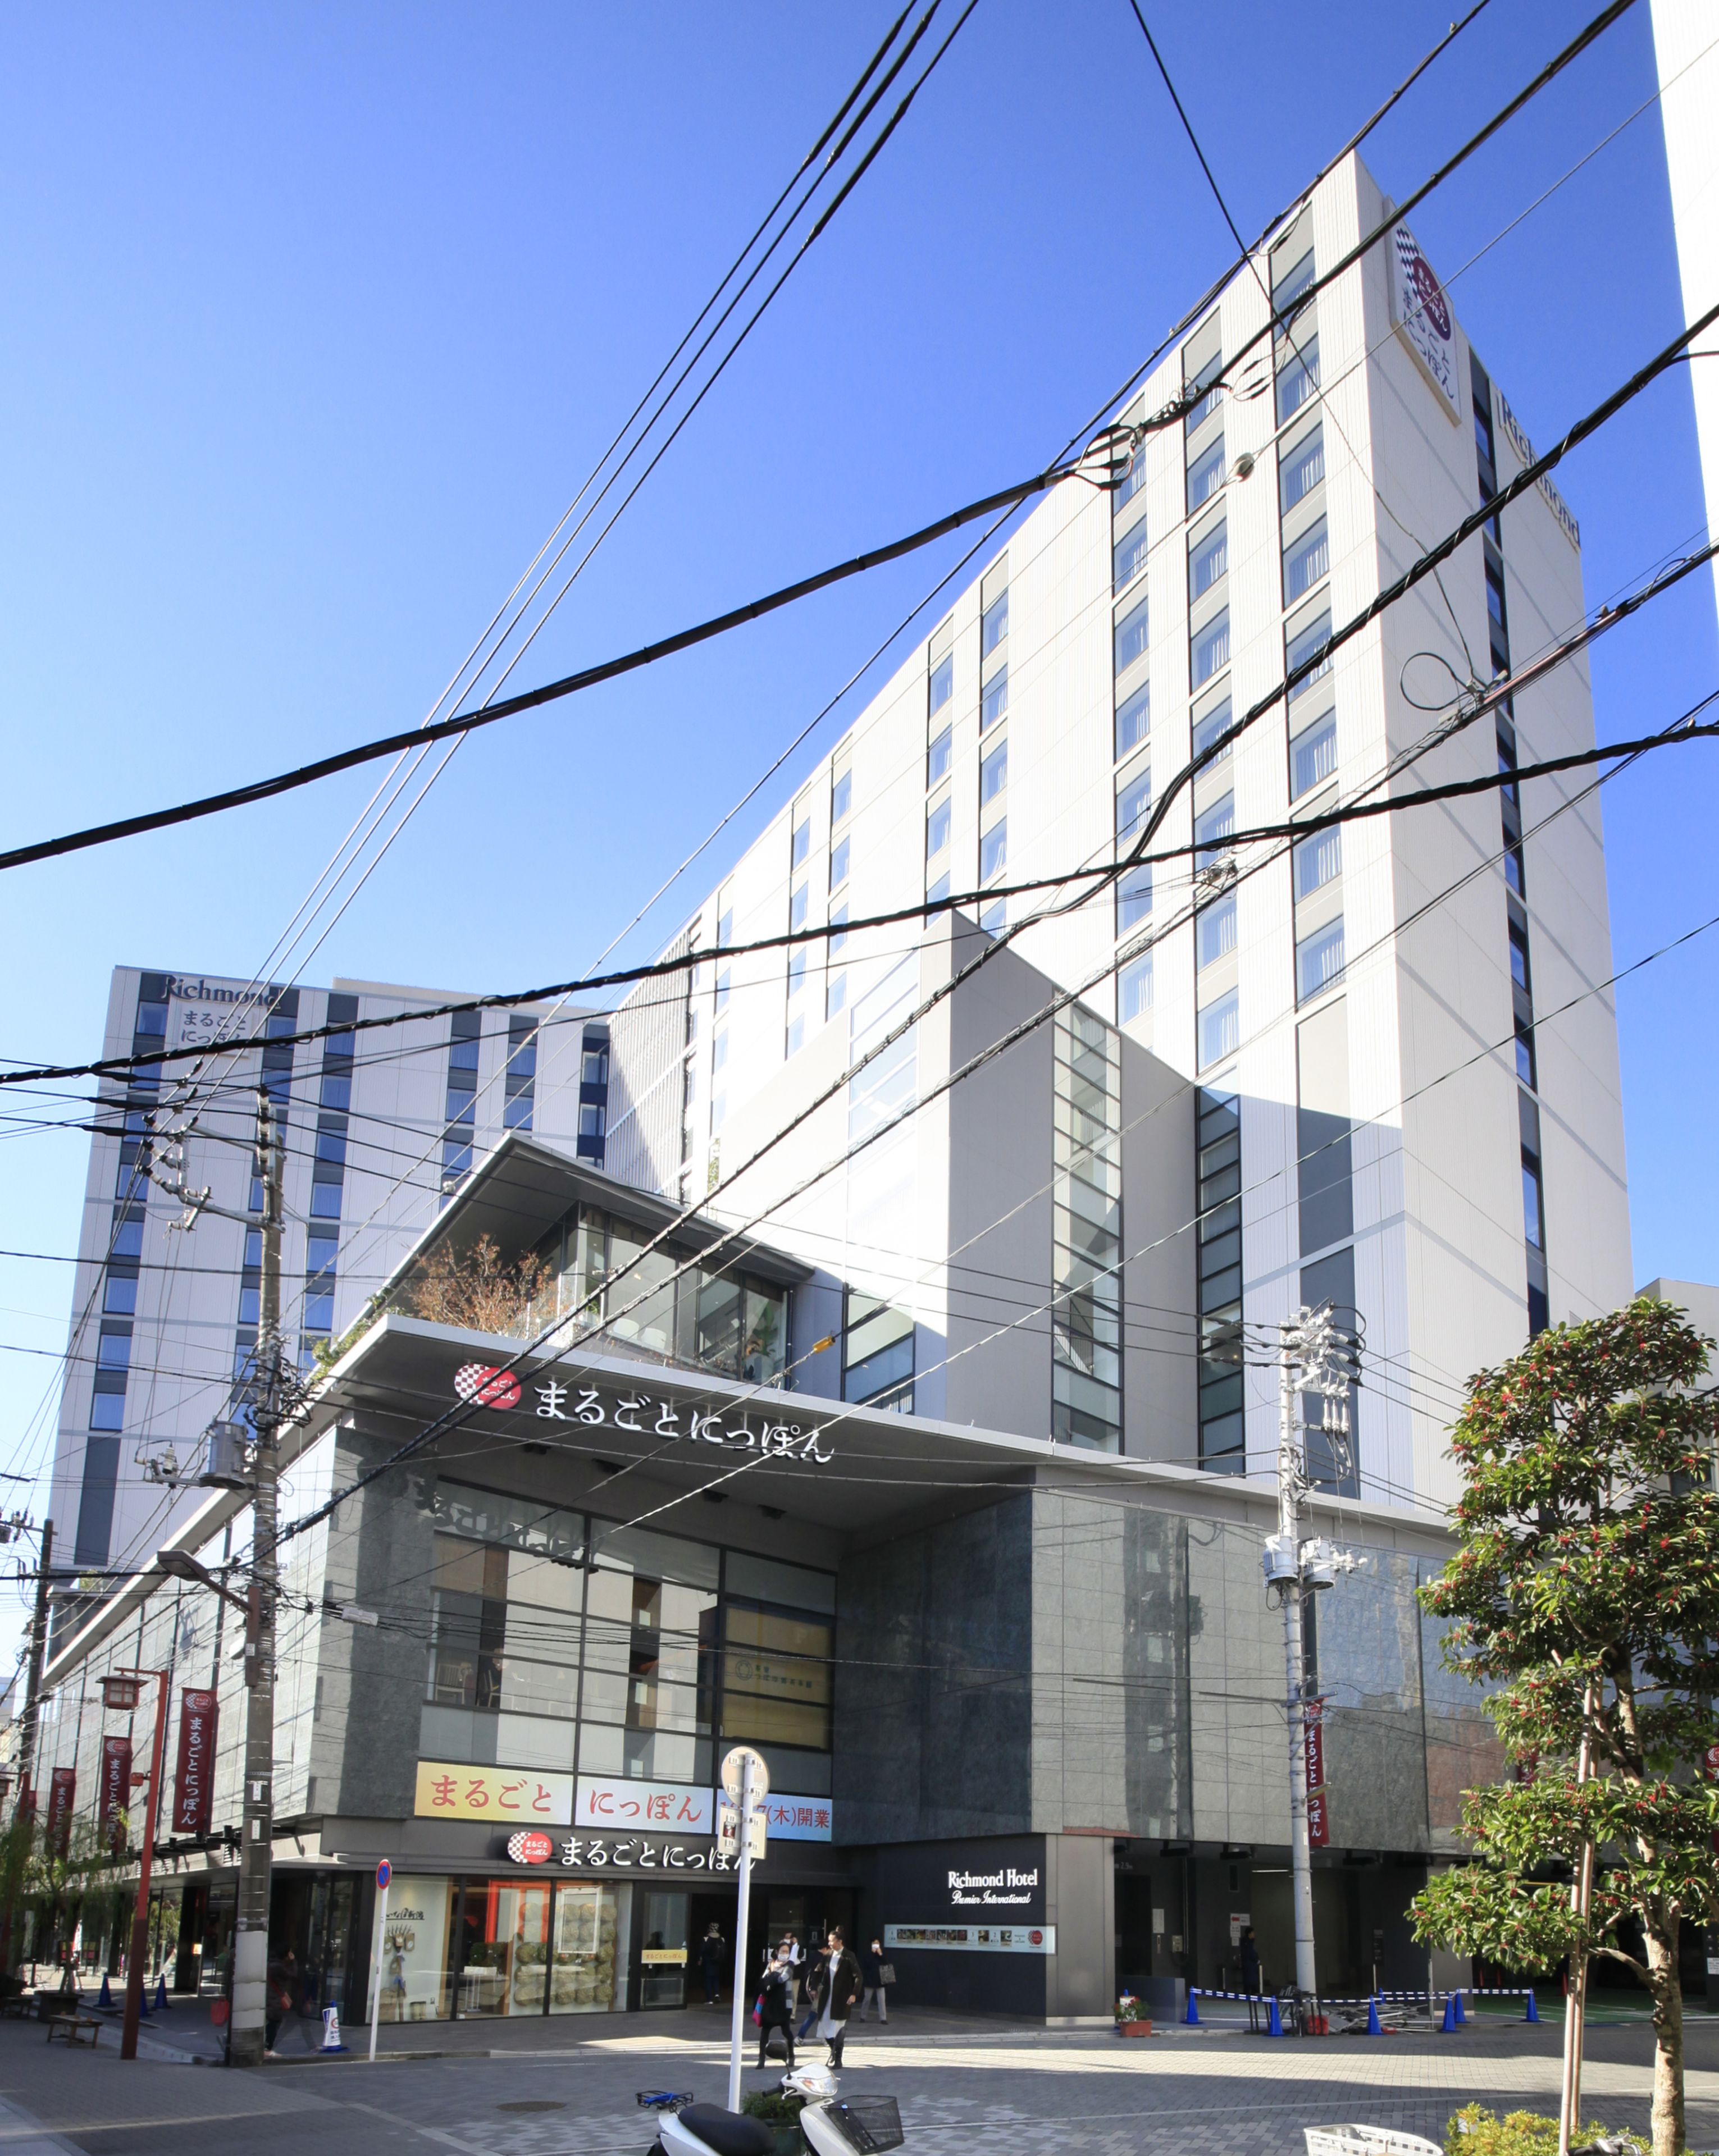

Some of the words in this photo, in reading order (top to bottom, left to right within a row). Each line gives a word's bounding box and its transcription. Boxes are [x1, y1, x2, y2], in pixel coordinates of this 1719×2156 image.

[161, 975, 281, 1010] Richmond
[534, 1380, 835, 1464] まるごとにっぽん
[181, 1716, 203, 1825] まるごとにっぽん
[431, 1774, 552, 1813] まるごと
[590, 1789, 702, 1822] にっぽん
[948, 1869, 1004, 1889] Richmond
[1006, 1868, 1038, 1888] Hotel
[951, 1890, 981, 1904] Premier
[981, 1889, 1032, 1904] International
